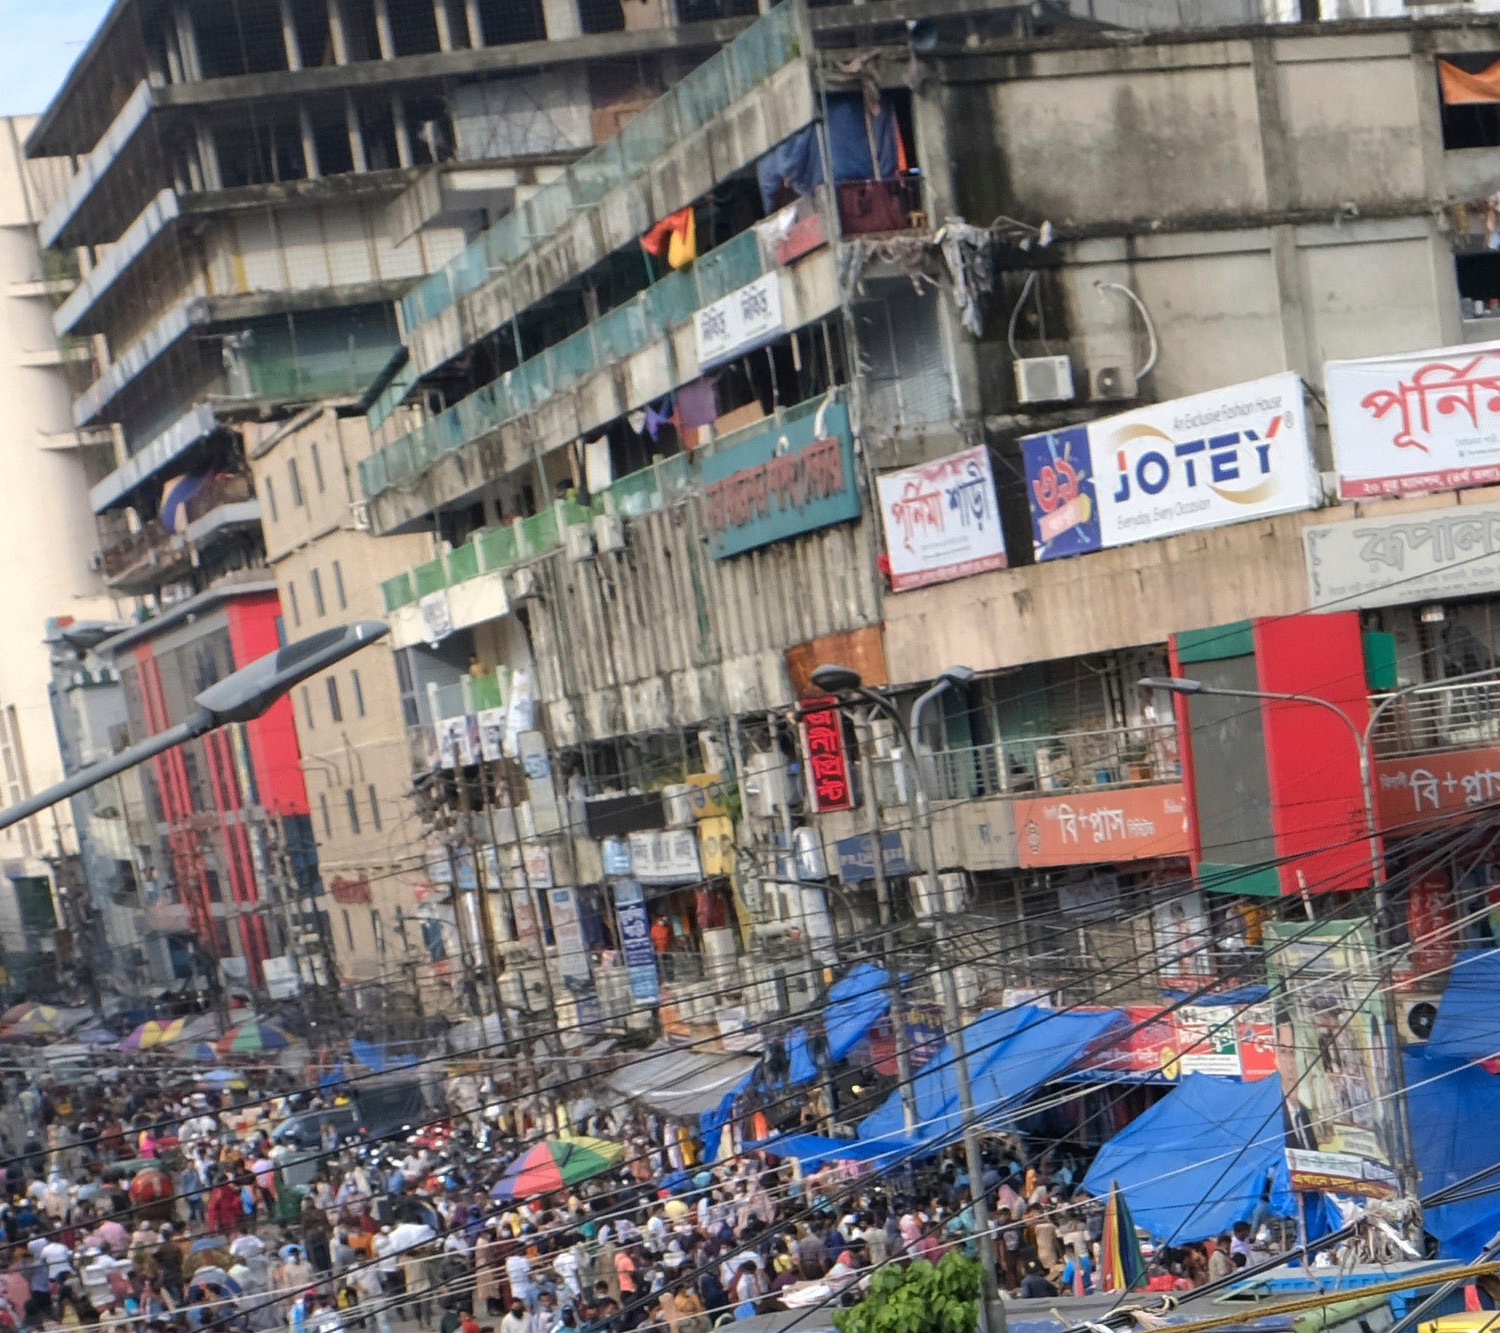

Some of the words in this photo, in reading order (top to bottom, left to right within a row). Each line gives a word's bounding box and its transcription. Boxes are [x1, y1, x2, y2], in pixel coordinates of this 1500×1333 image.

[1185, 409, 1220, 430] Exclusive
[1221, 402, 1252, 422] Fashion
[1254, 395, 1282, 414] House
[1114, 416, 1282, 503] JOTEY
